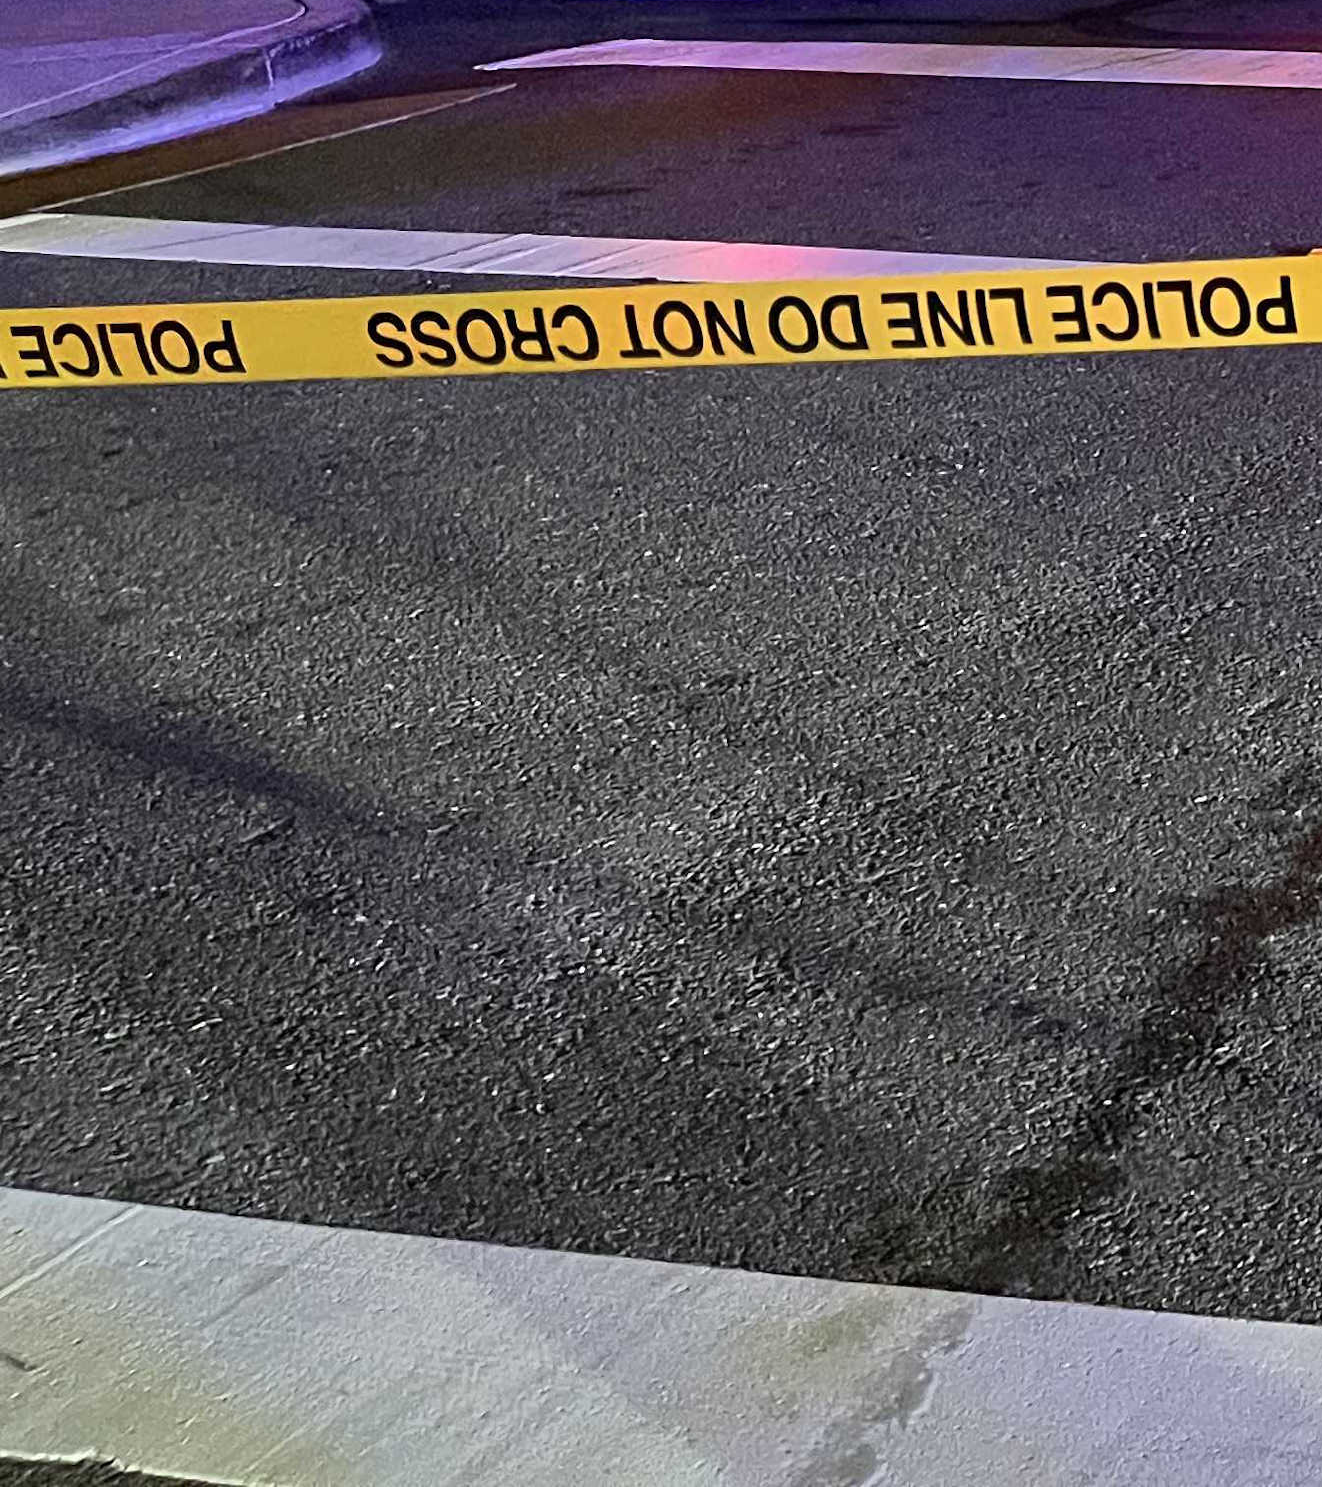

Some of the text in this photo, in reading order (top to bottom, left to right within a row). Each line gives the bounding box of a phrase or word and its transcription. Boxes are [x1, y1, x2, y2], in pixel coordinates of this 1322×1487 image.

[10, 320, 246, 377] POLICE
[368, 276, 1297, 368] POLICE LINE DO NOT CROSS
